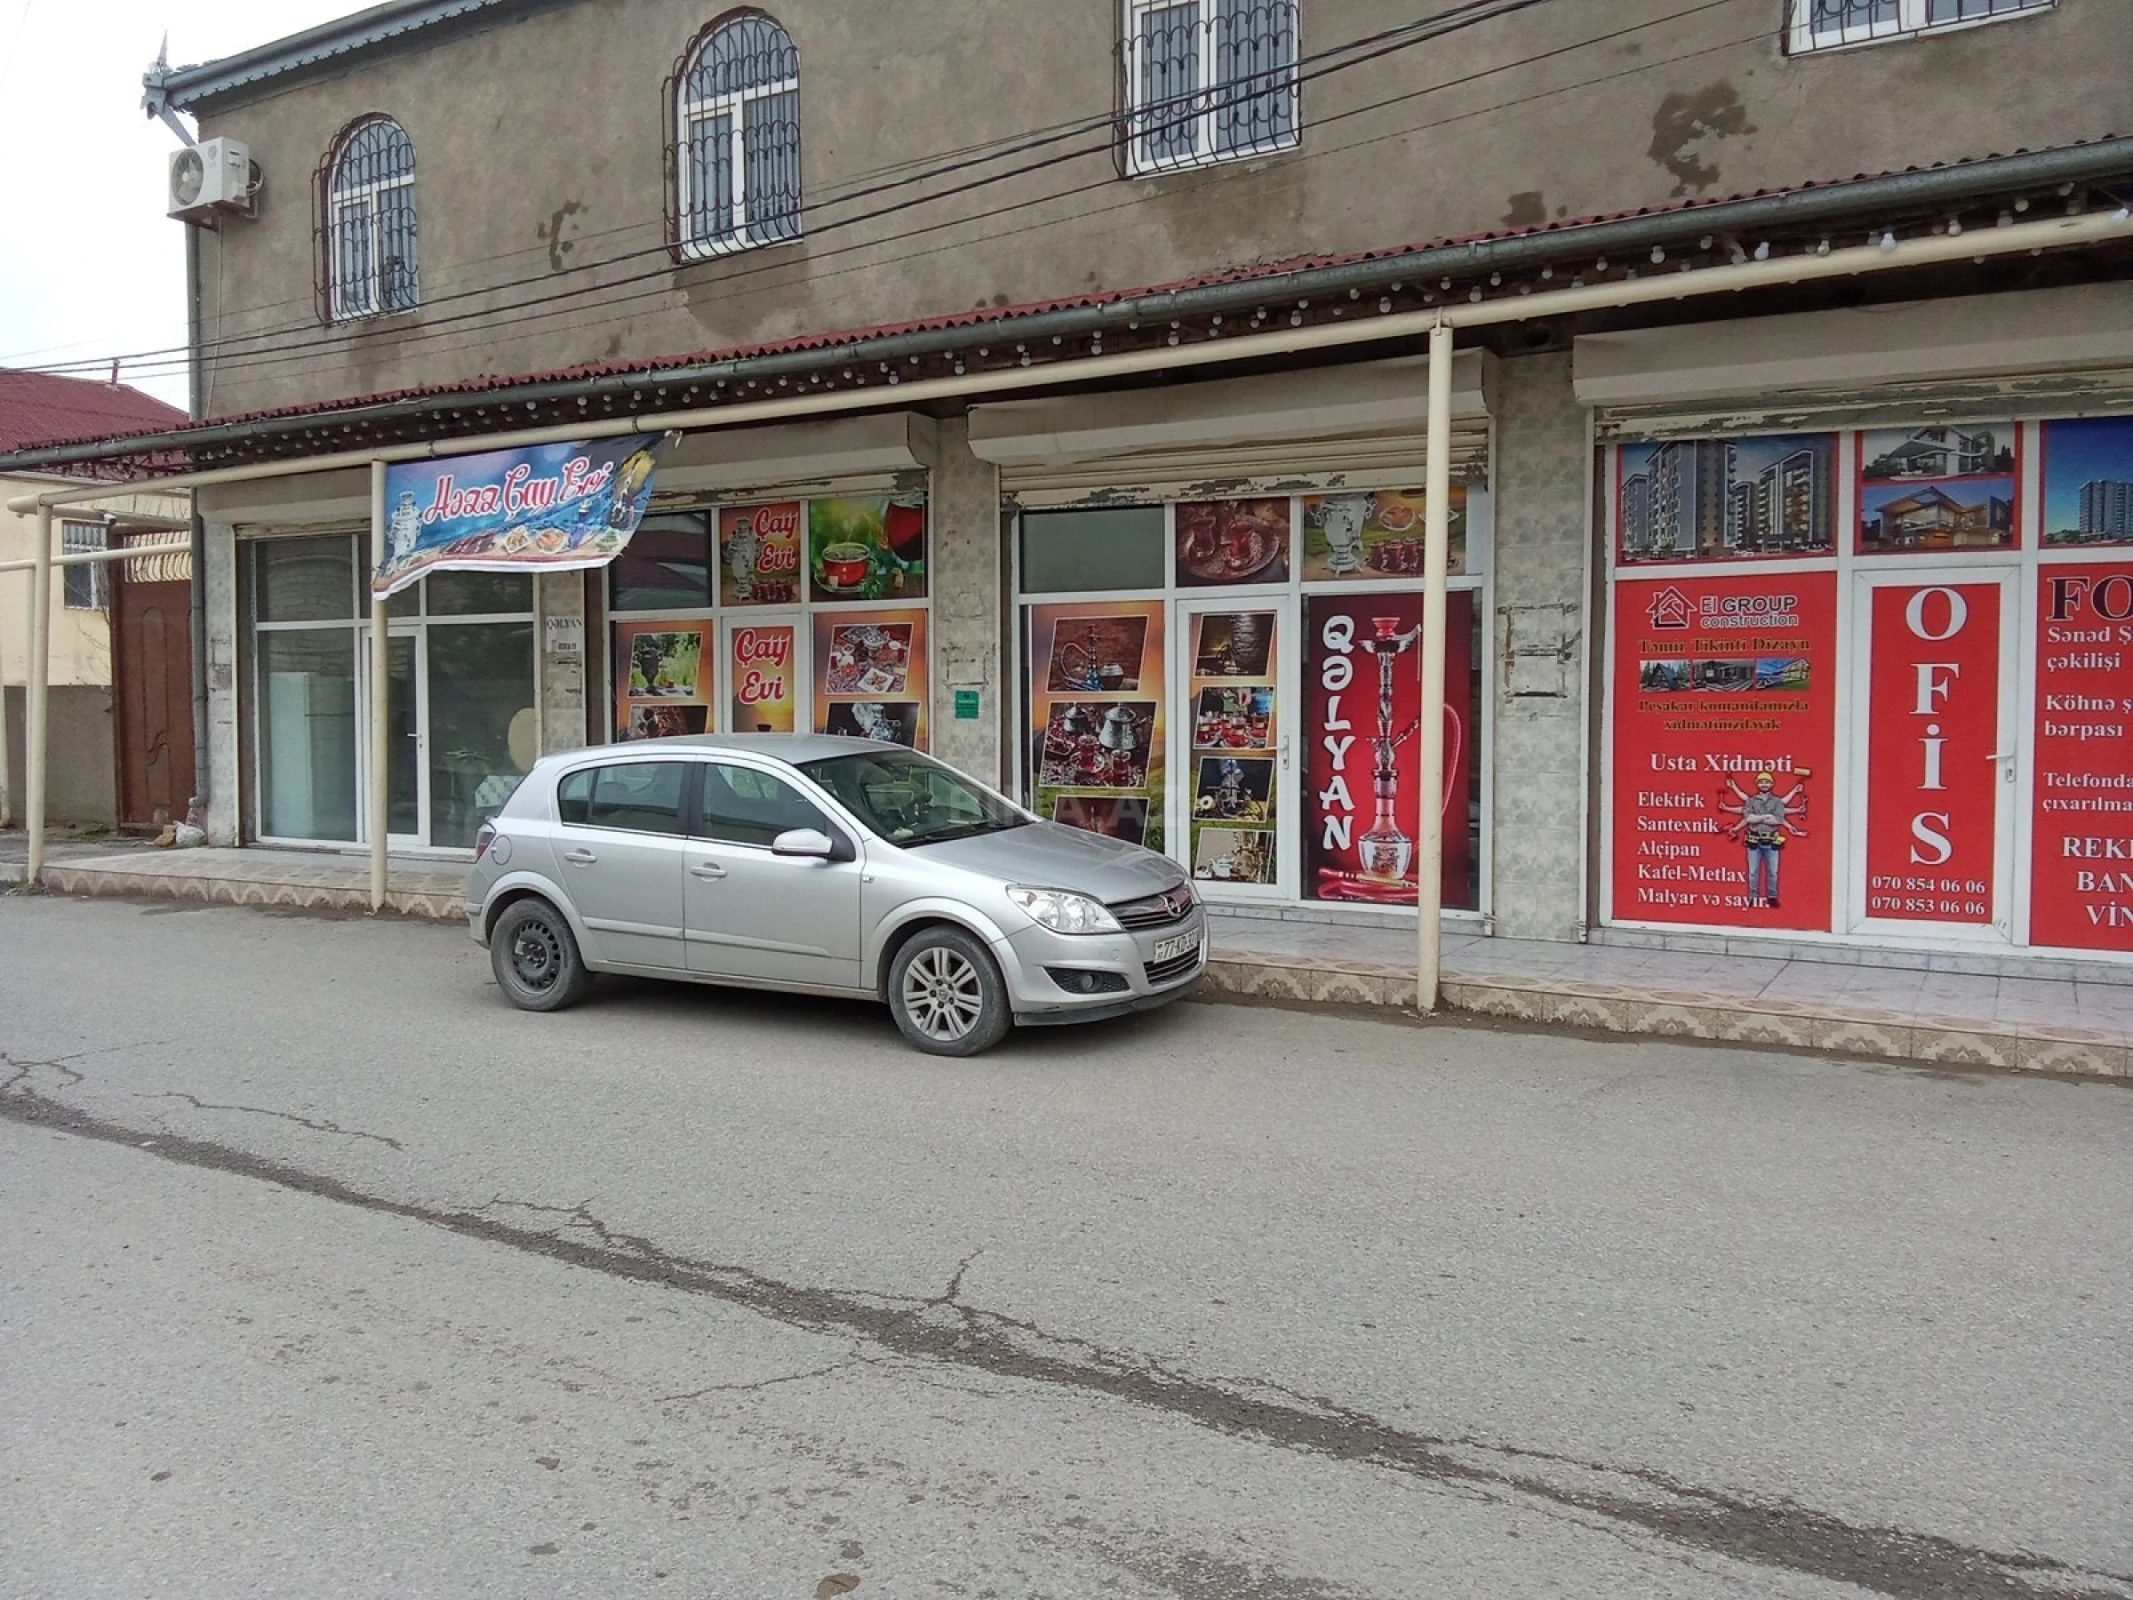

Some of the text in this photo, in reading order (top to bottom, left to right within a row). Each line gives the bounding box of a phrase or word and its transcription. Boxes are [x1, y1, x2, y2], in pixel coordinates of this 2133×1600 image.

[754, 507, 798, 541] Çay
[758, 543, 795, 573] Evi
[1721, 595, 1797, 614] GROUP
[1700, 613, 1799, 629] construction
[2047, 626, 2111, 643] Sənəd
[735, 629, 790, 668] Çay
[1693, 637, 1747, 652] Tikinti
[1752, 637, 1811, 654] Dizayn
[2047, 652, 2120, 672] çəkilişi
[739, 669, 784, 705] Evi
[2046, 694, 2115, 711] Köhnə
[1319, 615, 1356, 850] QƏLYAN
[1905, 587, 1968, 866] OFİS
[2044, 720, 2123, 741] bərpası
[1650, 753, 1793, 773] Usta Xidməti
[1637, 791, 1705, 809] Elektirk
[1637, 815, 1719, 833] Santexnik
[1637, 840, 1701, 859] Alçipan
[1637, 864, 1747, 883] Kafel-Metlax
[1872, 876, 1986, 894] 070 854 06 06
[1637, 887, 1698, 907] Malyar
[1702, 893, 1721, 906] və
[1871, 896, 1985, 915] 070 853 06 06
